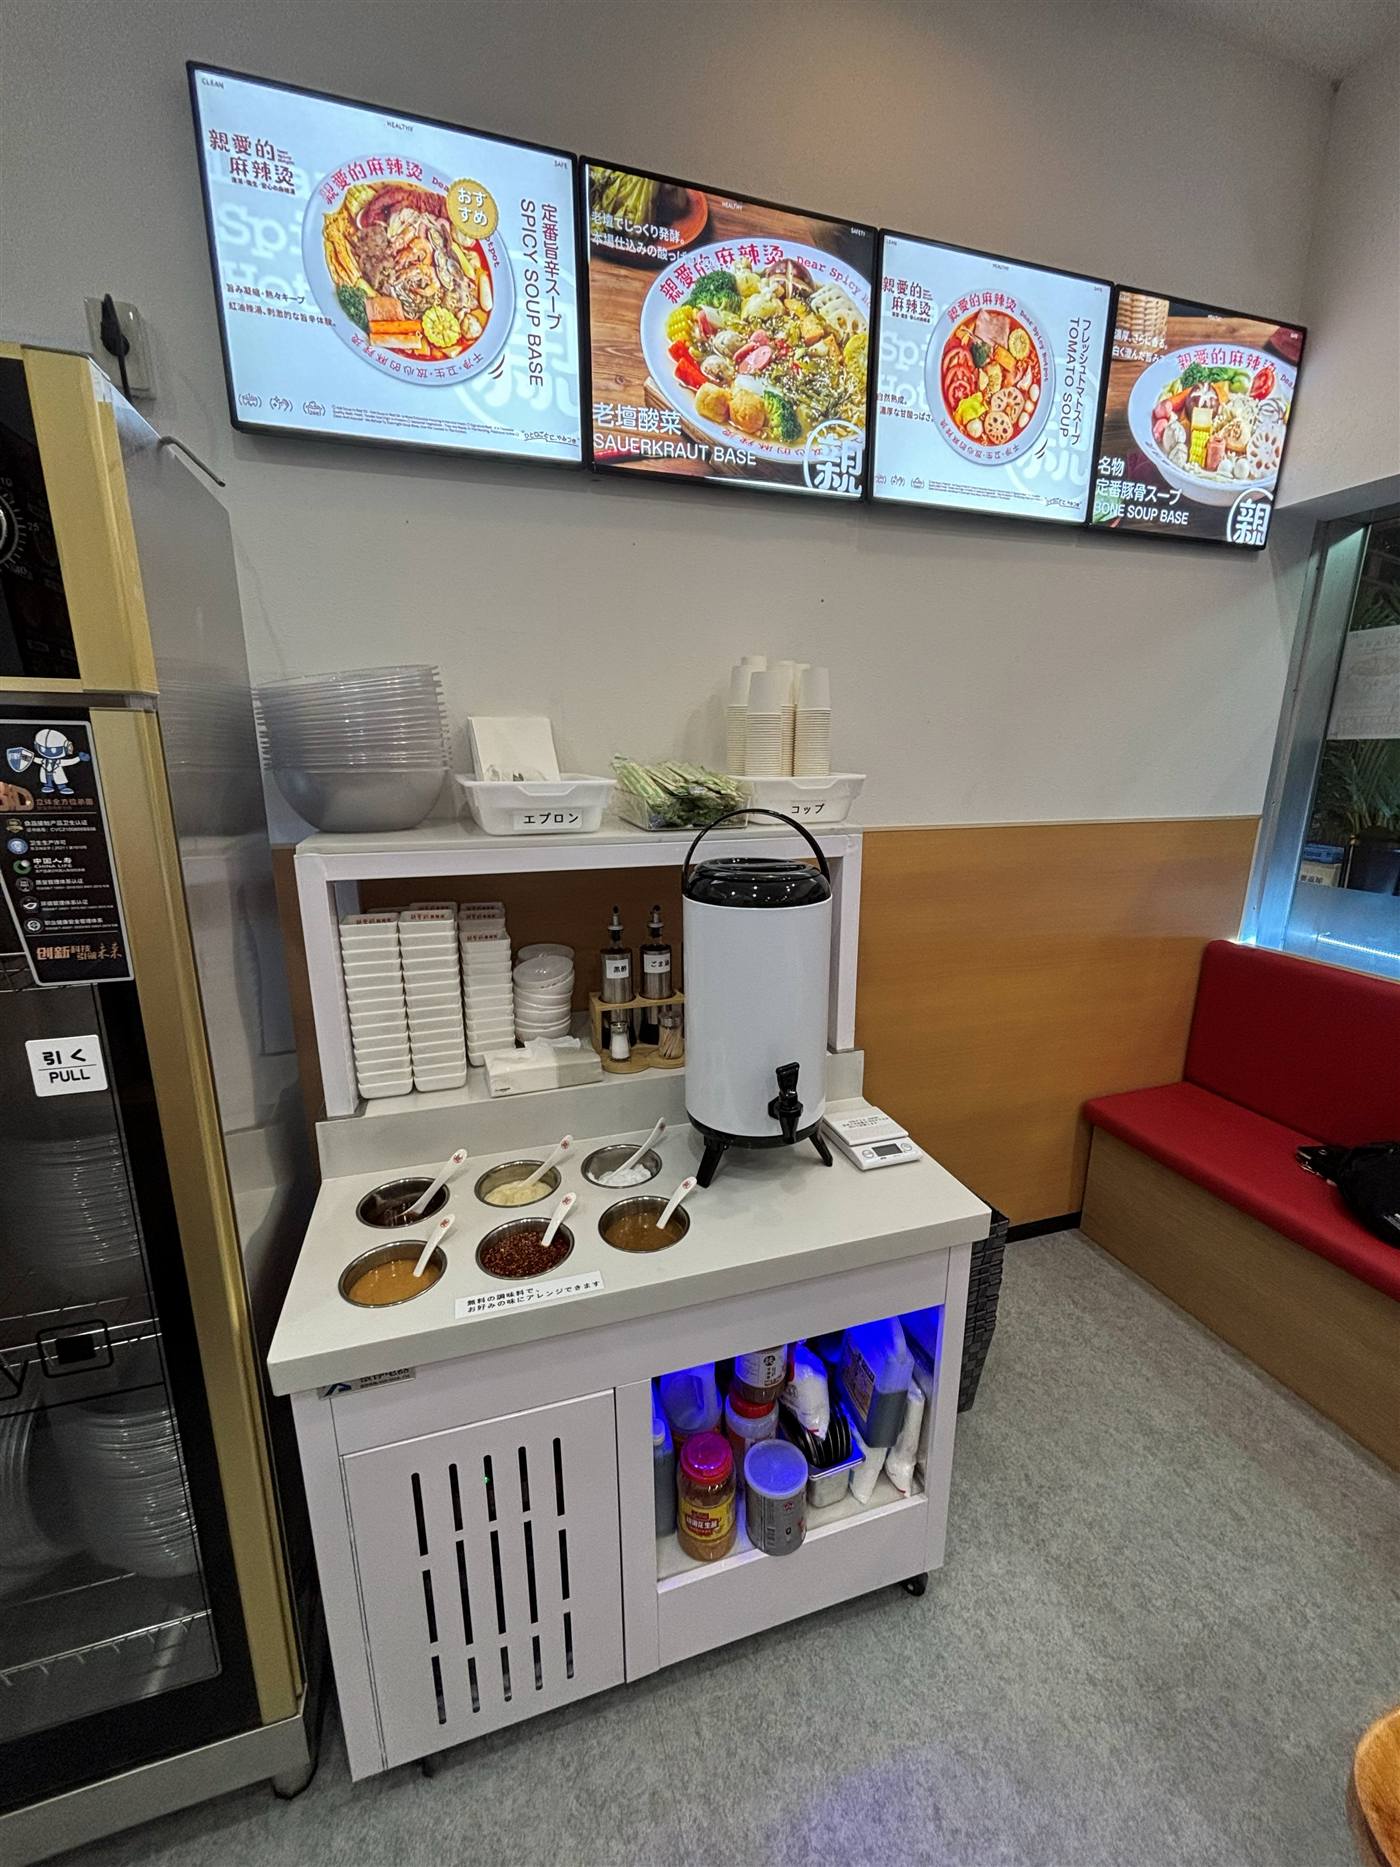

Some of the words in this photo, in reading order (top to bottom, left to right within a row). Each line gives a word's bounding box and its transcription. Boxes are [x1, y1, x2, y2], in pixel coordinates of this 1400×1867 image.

[208, 129, 275, 162] 親愛的
[520, 199, 539, 264] SPICY
[541, 203, 561, 330] 定番旨辛スープ
[796, 255, 826, 273] Dear
[524, 268, 541, 328] SOUP
[527, 334, 543, 386] BASE
[1063, 317, 1081, 388] TOMATO
[593, 402, 682, 436] 老壇酸菜
[1059, 392, 1073, 438] SOUP
[593, 433, 708, 461] SAUERKRAUT
[713, 446, 757, 465] BASE
[1097, 455, 1125, 477] 名物
[1096, 478, 1183, 506] 定番豚骨スープ
[1093, 500, 1126, 518] BONE
[1126, 504, 1159, 521] SOUP
[1159, 509, 1190, 526] BASE
[523, 811, 580, 825] エプロン
[791, 803, 825, 815] コップ
[42, 1048, 87, 1066] 引く
[49, 1068, 91, 1083] PULL
[467, 1281, 600, 1313] お好みの味にアレンジできます
